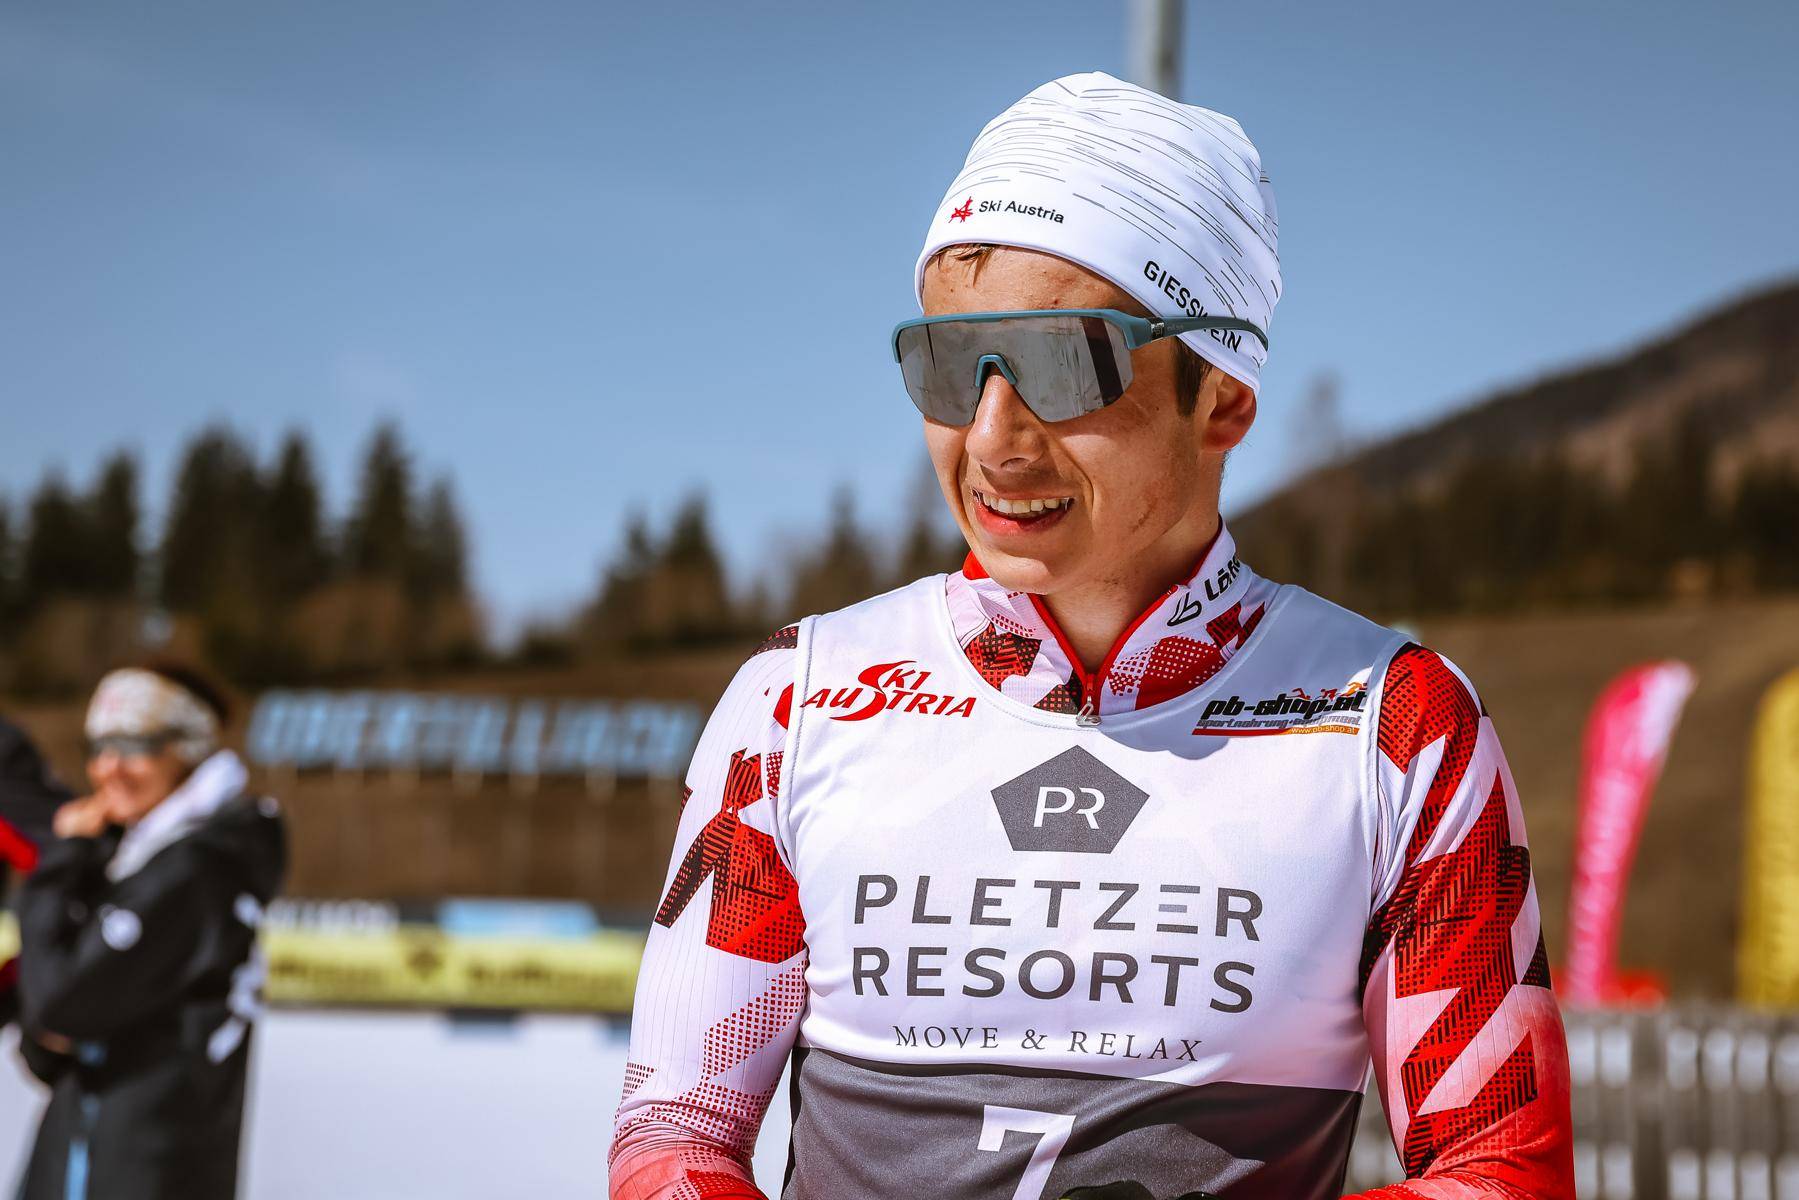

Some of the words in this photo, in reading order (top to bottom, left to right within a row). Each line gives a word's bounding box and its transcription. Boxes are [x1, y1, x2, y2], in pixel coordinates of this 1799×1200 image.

[979, 200, 1002, 213] Ski
[1004, 200, 1065, 224] Austria
[800, 680, 977, 721] AUSTRIA
[1200, 691, 1368, 719] pb-shop.at
[1033, 785, 1106, 830] PR
[853, 874, 1263, 942] PLETZER
[852, 946, 1256, 1014] RESORTS
[893, 1025, 999, 1049] MOVE
[1020, 1029, 1048, 1050] &
[1068, 1030, 1202, 1062] RELAX
[977, 1104, 1076, 1200] 7
